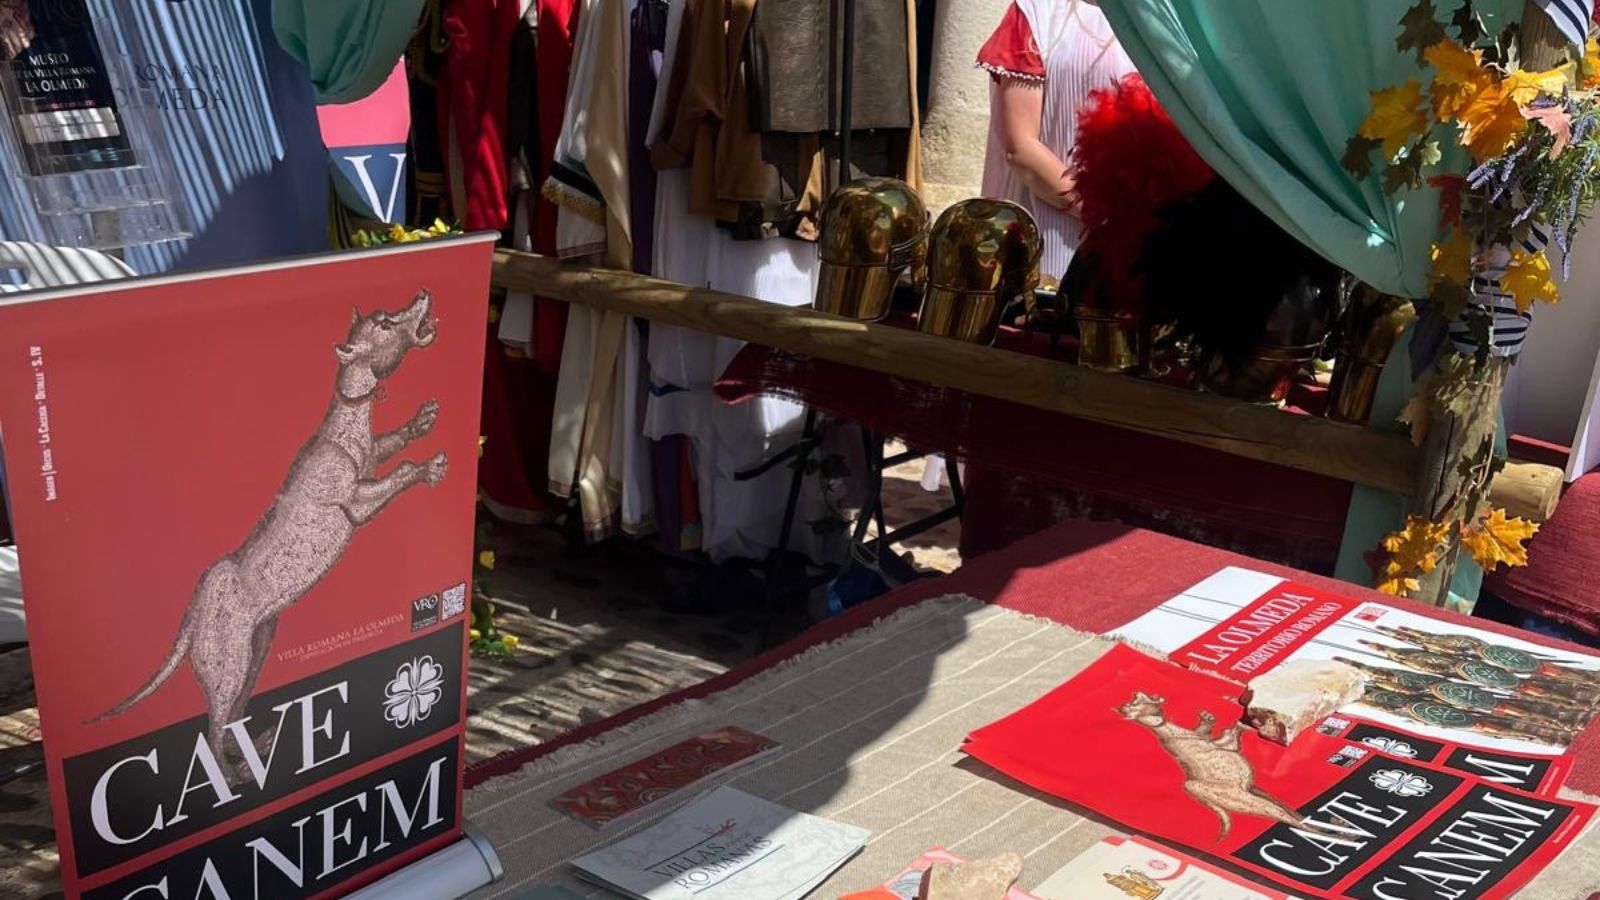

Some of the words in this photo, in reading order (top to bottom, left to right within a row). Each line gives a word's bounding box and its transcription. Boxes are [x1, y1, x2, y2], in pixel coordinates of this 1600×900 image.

[25, 82, 40, 93] LA
[40, 78, 90, 92] OLMEDA
[29, 53, 69, 66] MUSEO
[413, 594, 439, 611] VRO
[1187, 642, 1240, 665] LA
[1217, 592, 1316, 645] OLMEDA
[277, 647, 304, 662] VILLA
[306, 630, 352, 653] ROMANA
[365, 613, 405, 634] OLMEDA
[1230, 623, 1301, 674] TERRITORIO
[1293, 602, 1343, 632] ROMANO
[91, 680, 350, 845] CAVE
[121, 757, 448, 900] ANEM
[1259, 791, 1409, 876] CAVE
[652, 842, 726, 878] VILLAS
[674, 835, 773, 889] ROMANAS
